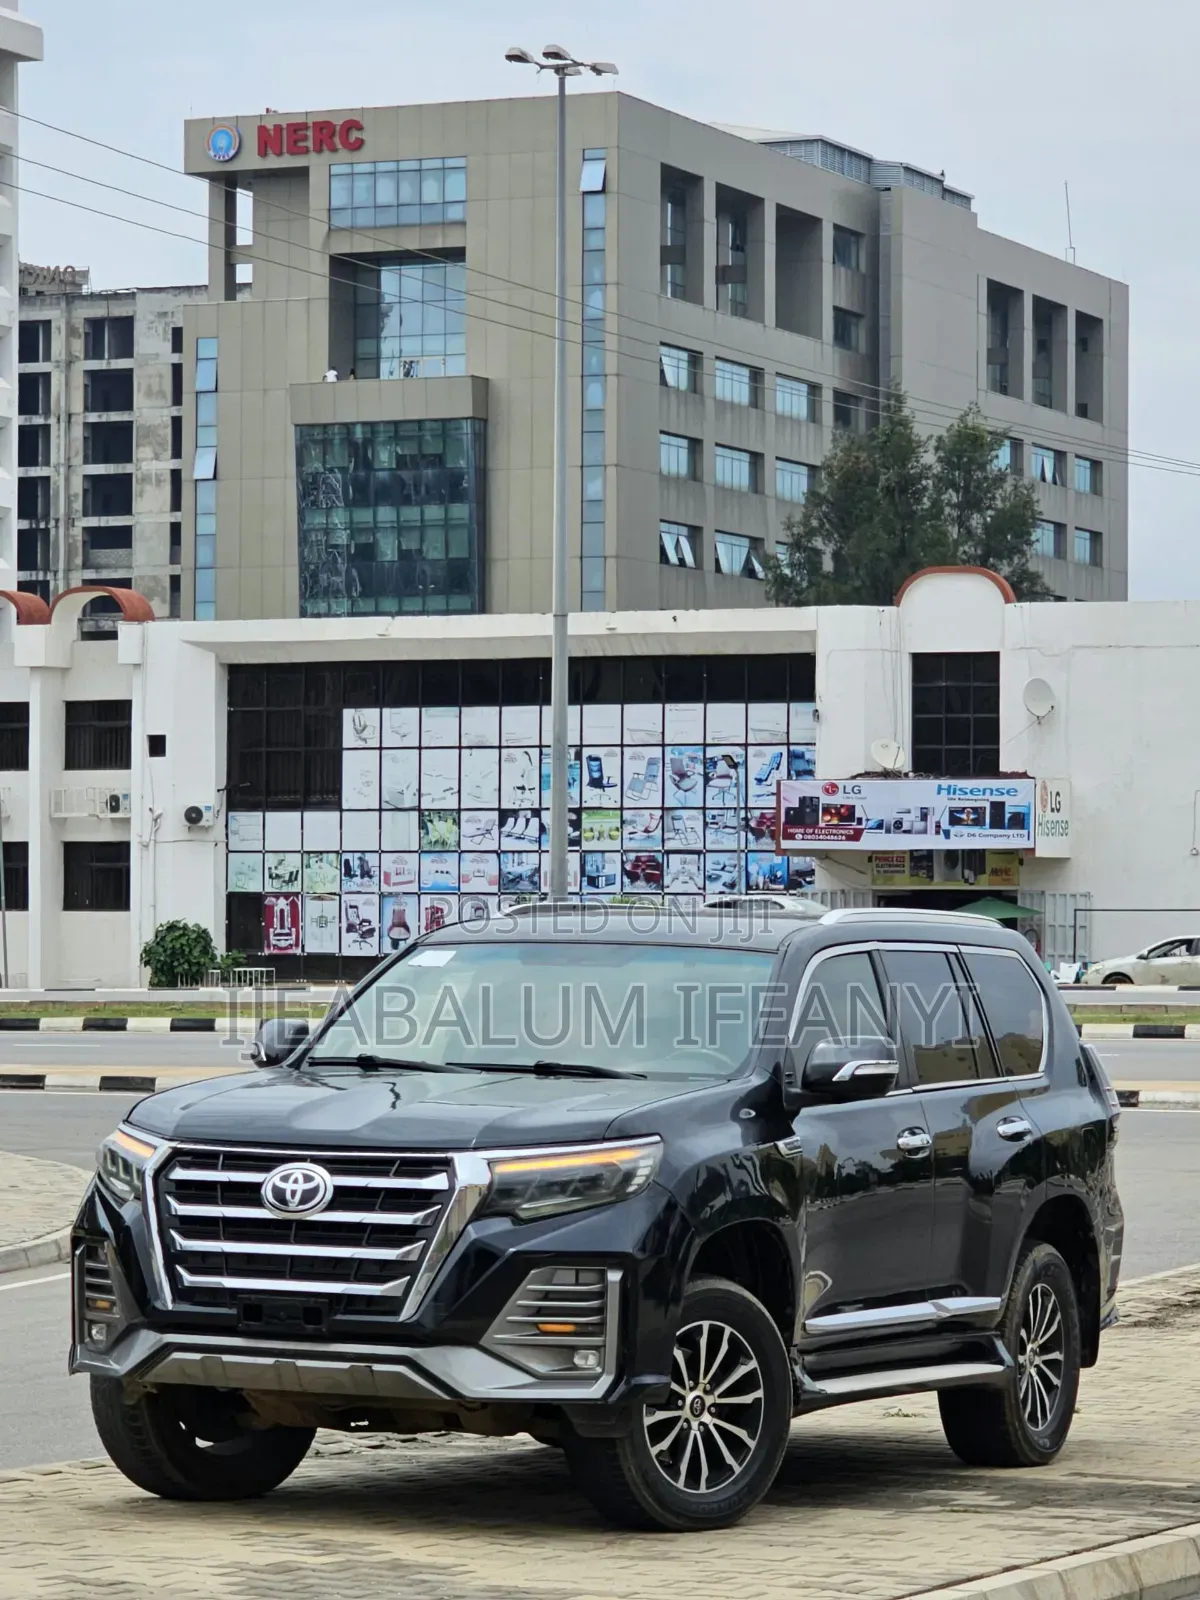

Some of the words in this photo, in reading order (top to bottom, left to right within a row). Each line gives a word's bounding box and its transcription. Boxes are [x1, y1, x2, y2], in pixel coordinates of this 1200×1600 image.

[257, 119, 365, 157] NERC
[843, 785, 862, 795] LG
[937, 784, 1018, 796] Hisense
[1050, 791, 1061, 813] LG
[1037, 814, 1069, 837] Hisense
